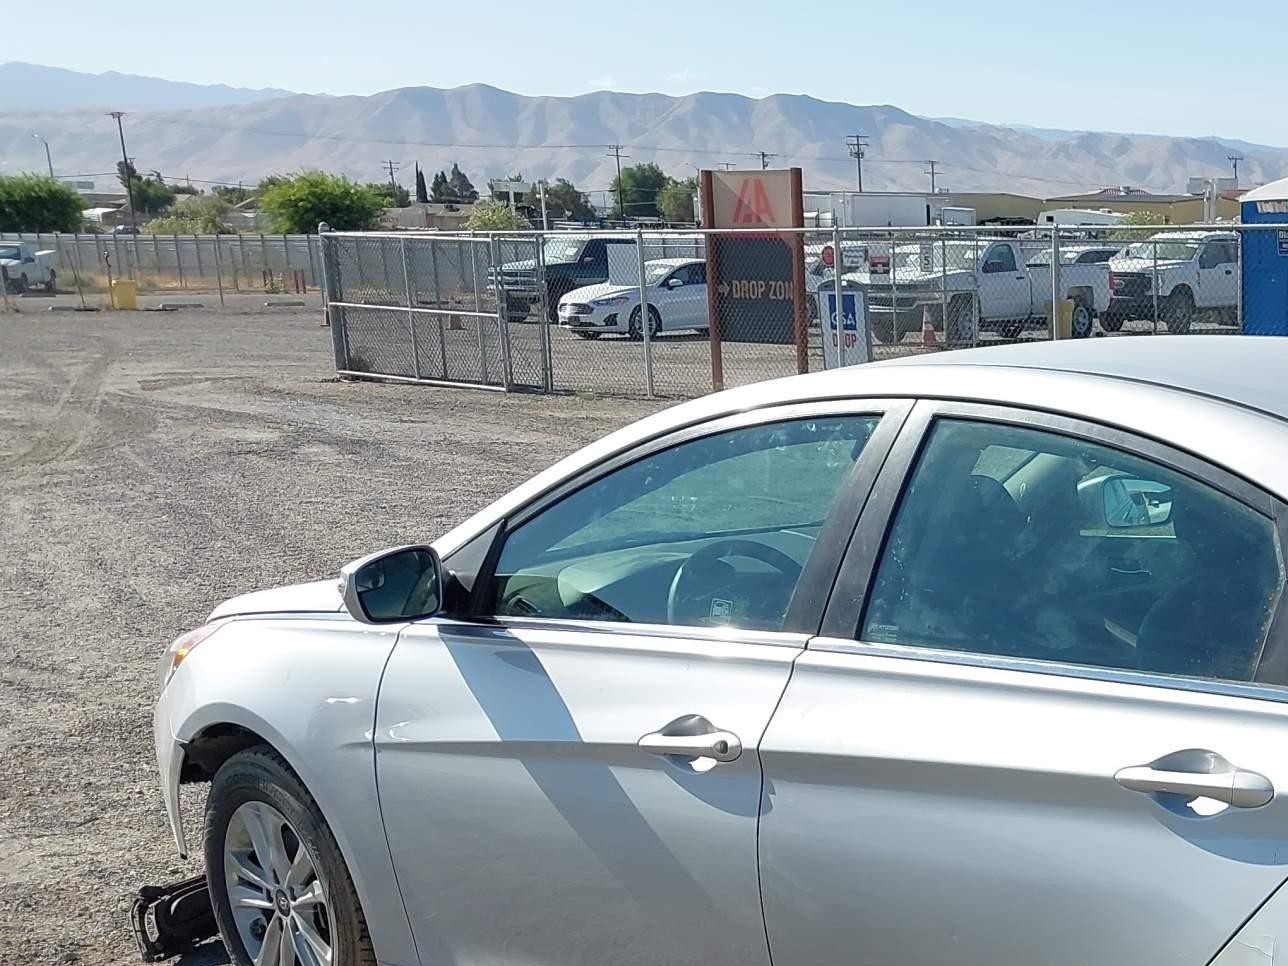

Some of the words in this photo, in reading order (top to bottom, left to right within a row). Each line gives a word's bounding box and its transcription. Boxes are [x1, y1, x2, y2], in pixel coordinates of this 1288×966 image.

[732, 280, 766, 299] DROP
[769, 281, 794, 300] ZON
[832, 333, 857, 349] DOP
